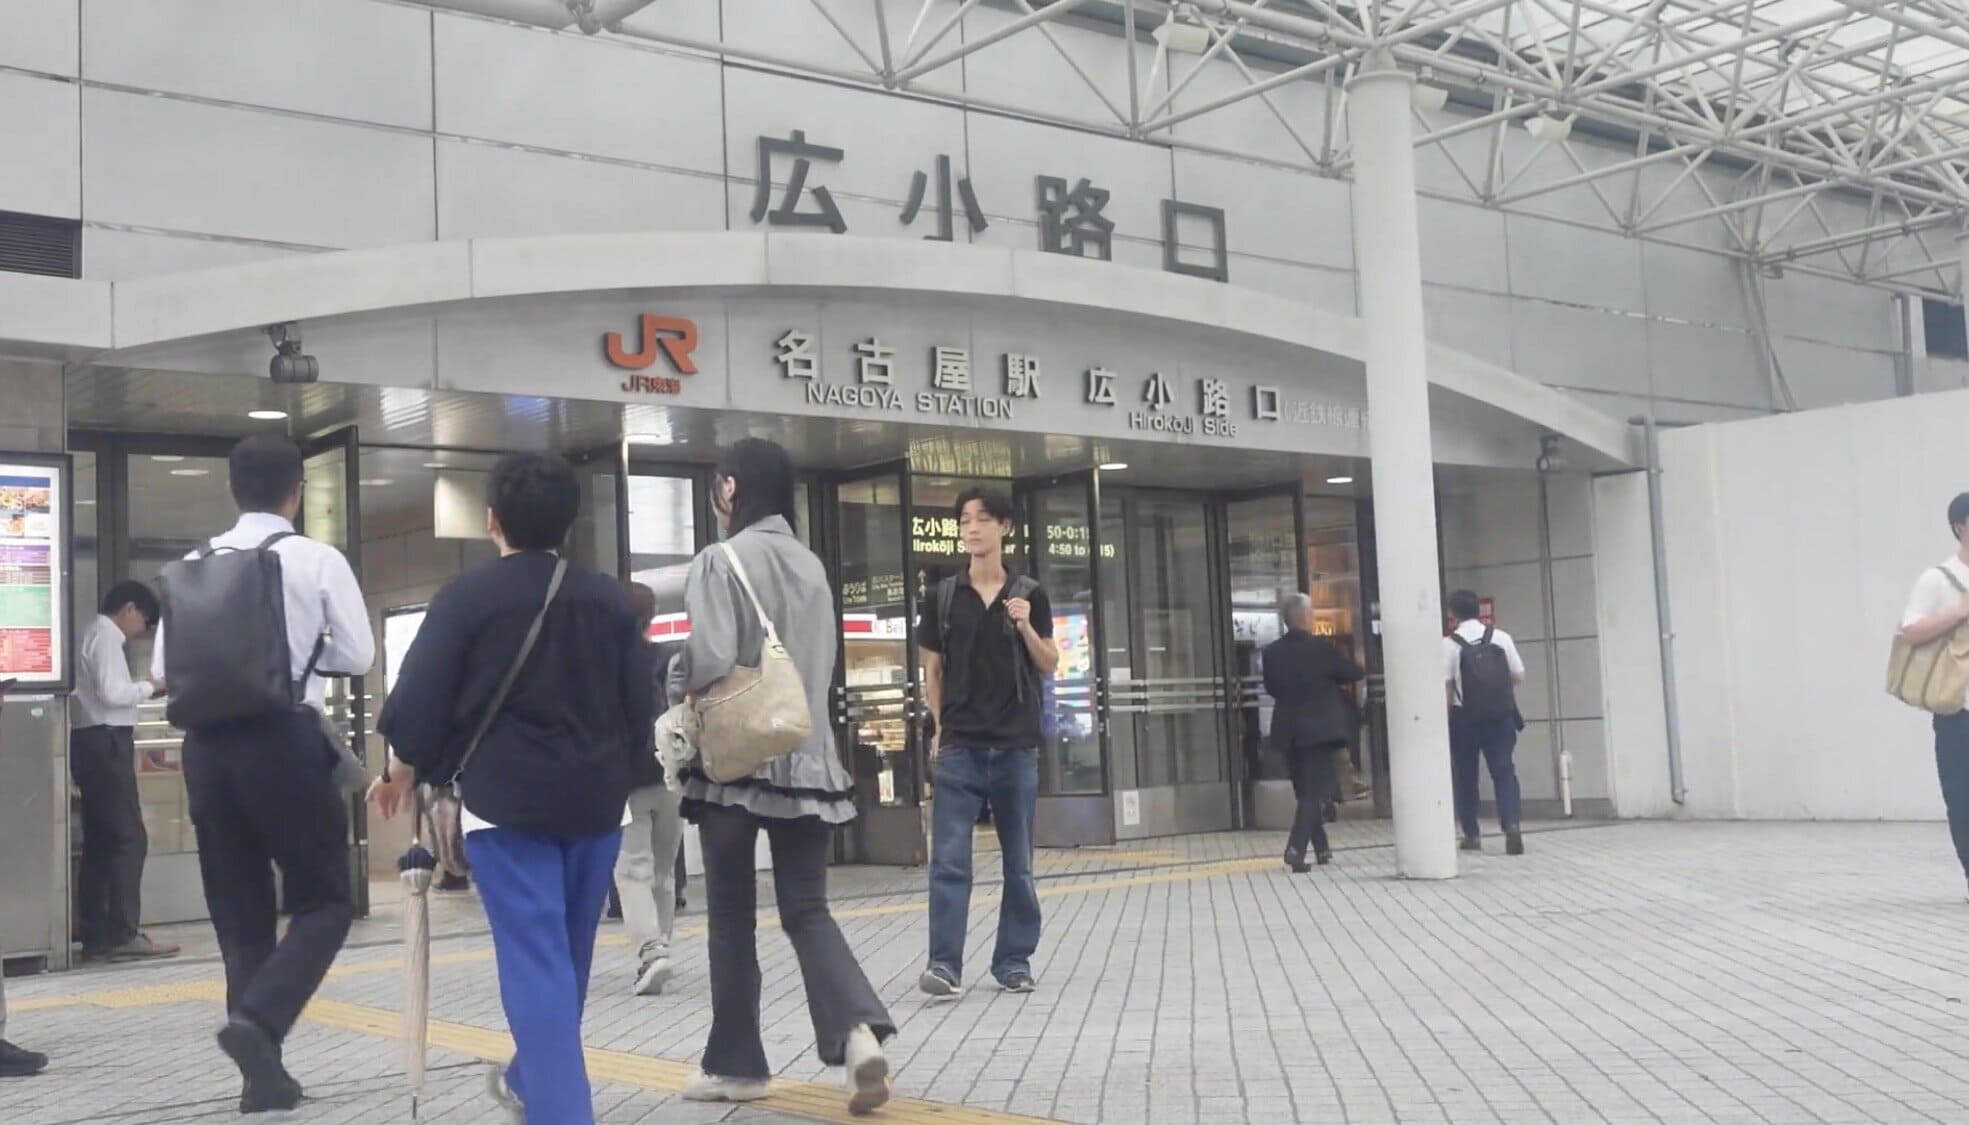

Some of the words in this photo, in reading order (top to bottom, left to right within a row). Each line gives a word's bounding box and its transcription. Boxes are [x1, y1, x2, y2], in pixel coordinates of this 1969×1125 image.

[749, 129, 1229, 282] 広小路口
[605, 313, 698, 374] JR
[780, 328, 1040, 398] 名古屋駅
[1088, 366, 1281, 422] 広小路口
[807, 383, 904, 409] NAGOYA
[916, 392, 1014, 418] STATION
[1203, 417, 1240, 437] Side
